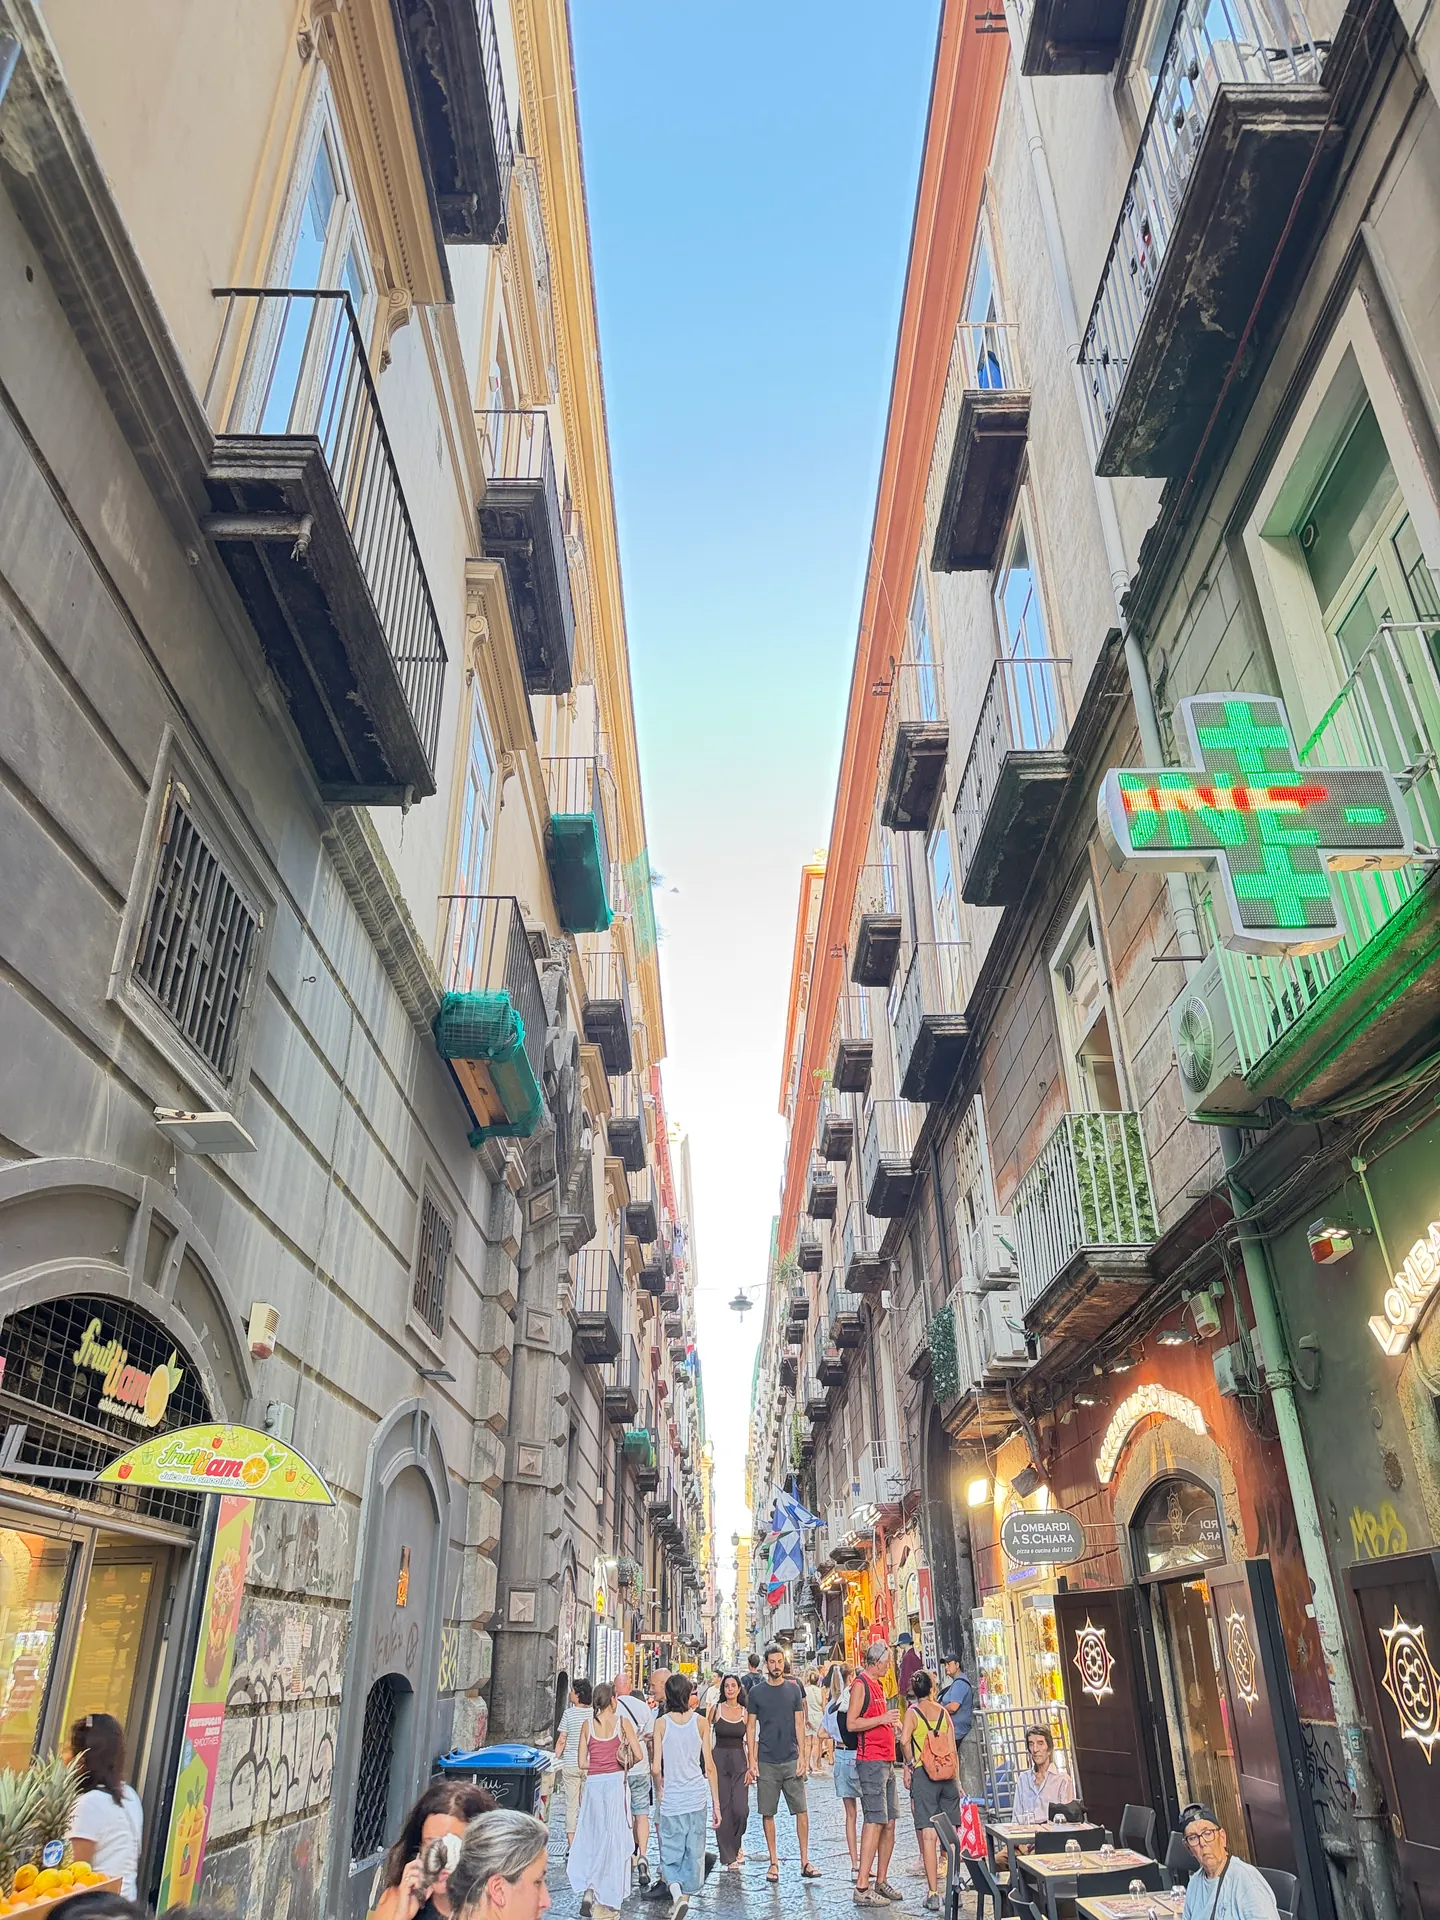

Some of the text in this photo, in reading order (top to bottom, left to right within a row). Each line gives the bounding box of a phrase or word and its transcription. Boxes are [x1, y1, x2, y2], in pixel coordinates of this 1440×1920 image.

[1013, 1522, 1071, 1533] LOMBARDI
[1012, 1533, 1075, 1545] A S.CHIARA
[1016, 1547, 1030, 1556] pizza
